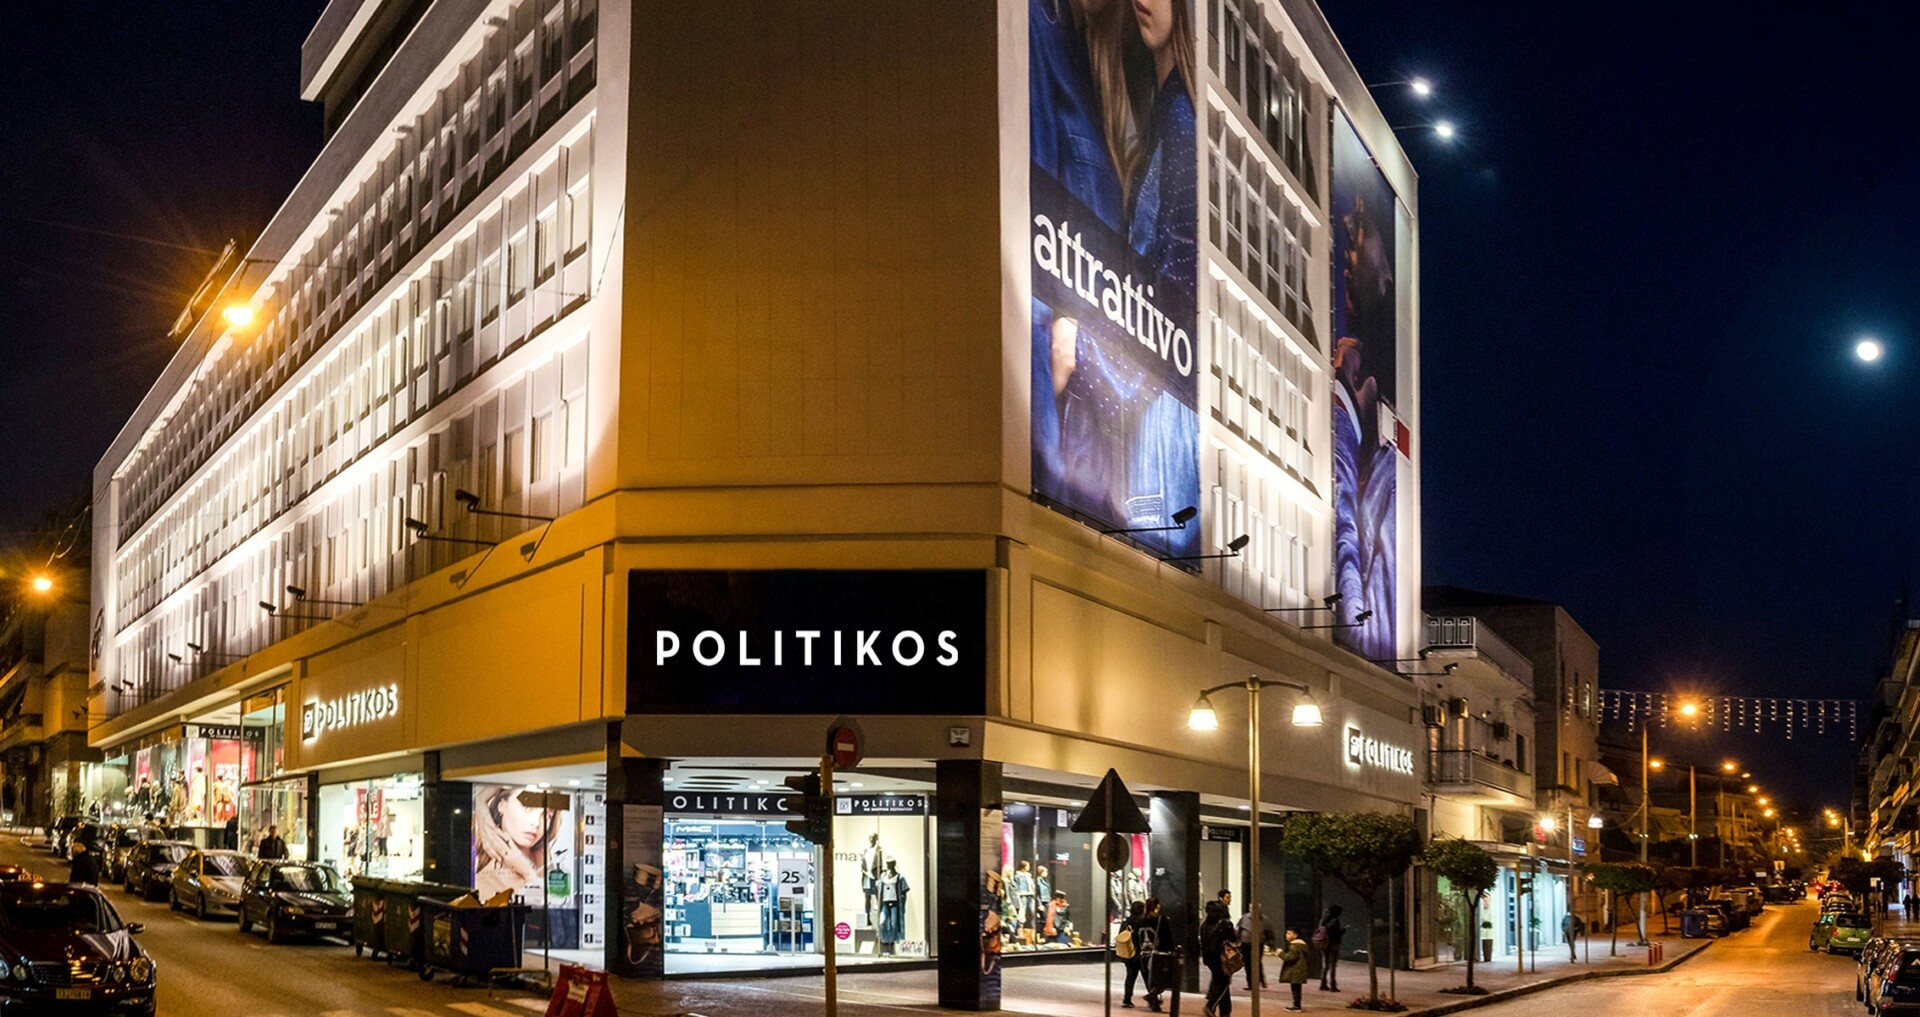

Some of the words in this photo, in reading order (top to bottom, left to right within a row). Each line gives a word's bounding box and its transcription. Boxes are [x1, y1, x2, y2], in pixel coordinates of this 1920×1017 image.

[1033, 212, 1193, 378] attrattivo
[656, 629, 959, 667] POLITIKOS
[317, 684, 398, 732] POLITIKOS
[201, 727, 259, 738] POLITIOS
[672, 795, 789, 811] OLITIKO
[853, 799, 923, 807] POLITIKOS
[781, 870, 800, 884] 25
